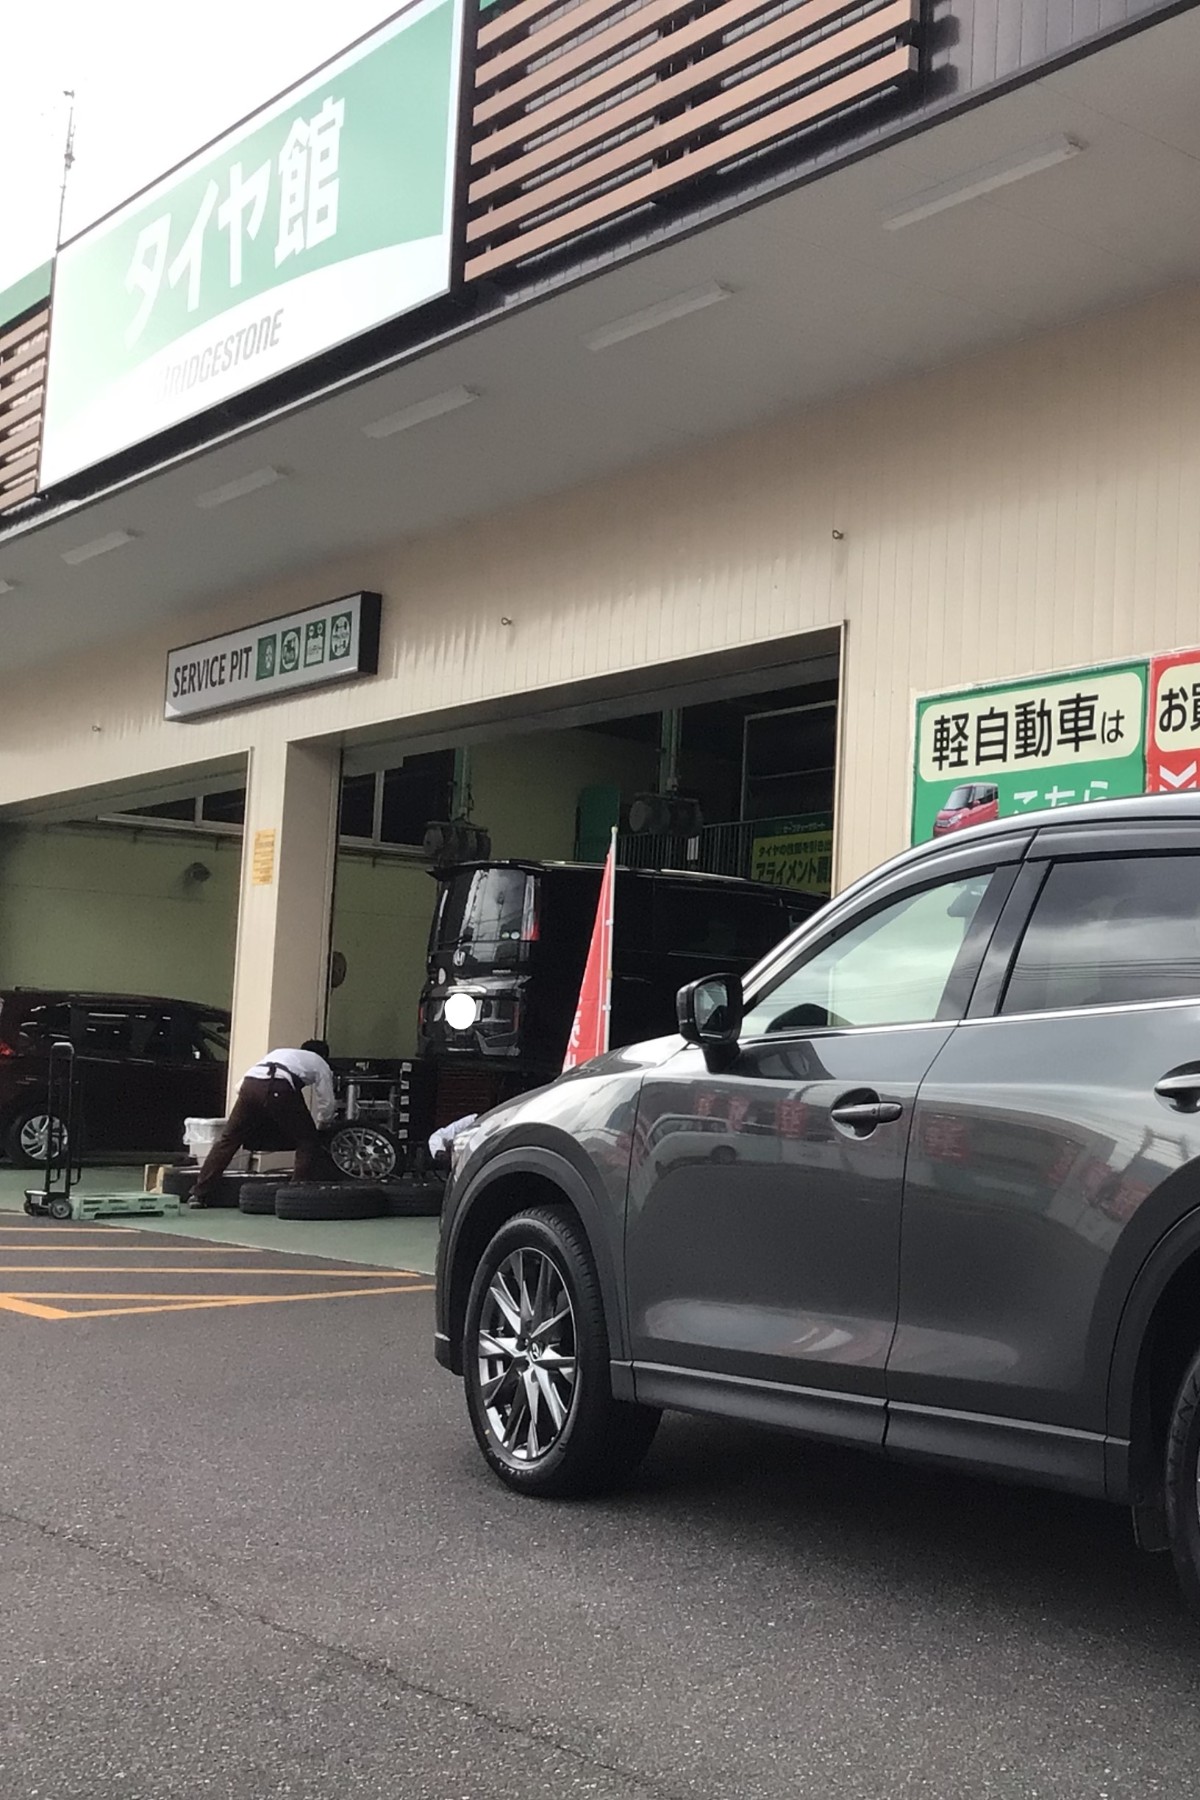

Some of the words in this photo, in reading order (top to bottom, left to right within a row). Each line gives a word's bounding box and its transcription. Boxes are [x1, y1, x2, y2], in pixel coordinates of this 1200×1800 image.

[122, 95, 346, 353] タイヤ館
[156, 307, 284, 400] RIDGESTONE
[172, 652, 227, 698] SERVICE
[229, 646, 253, 683] PIT
[931, 692, 1126, 772] 軽自動車は
